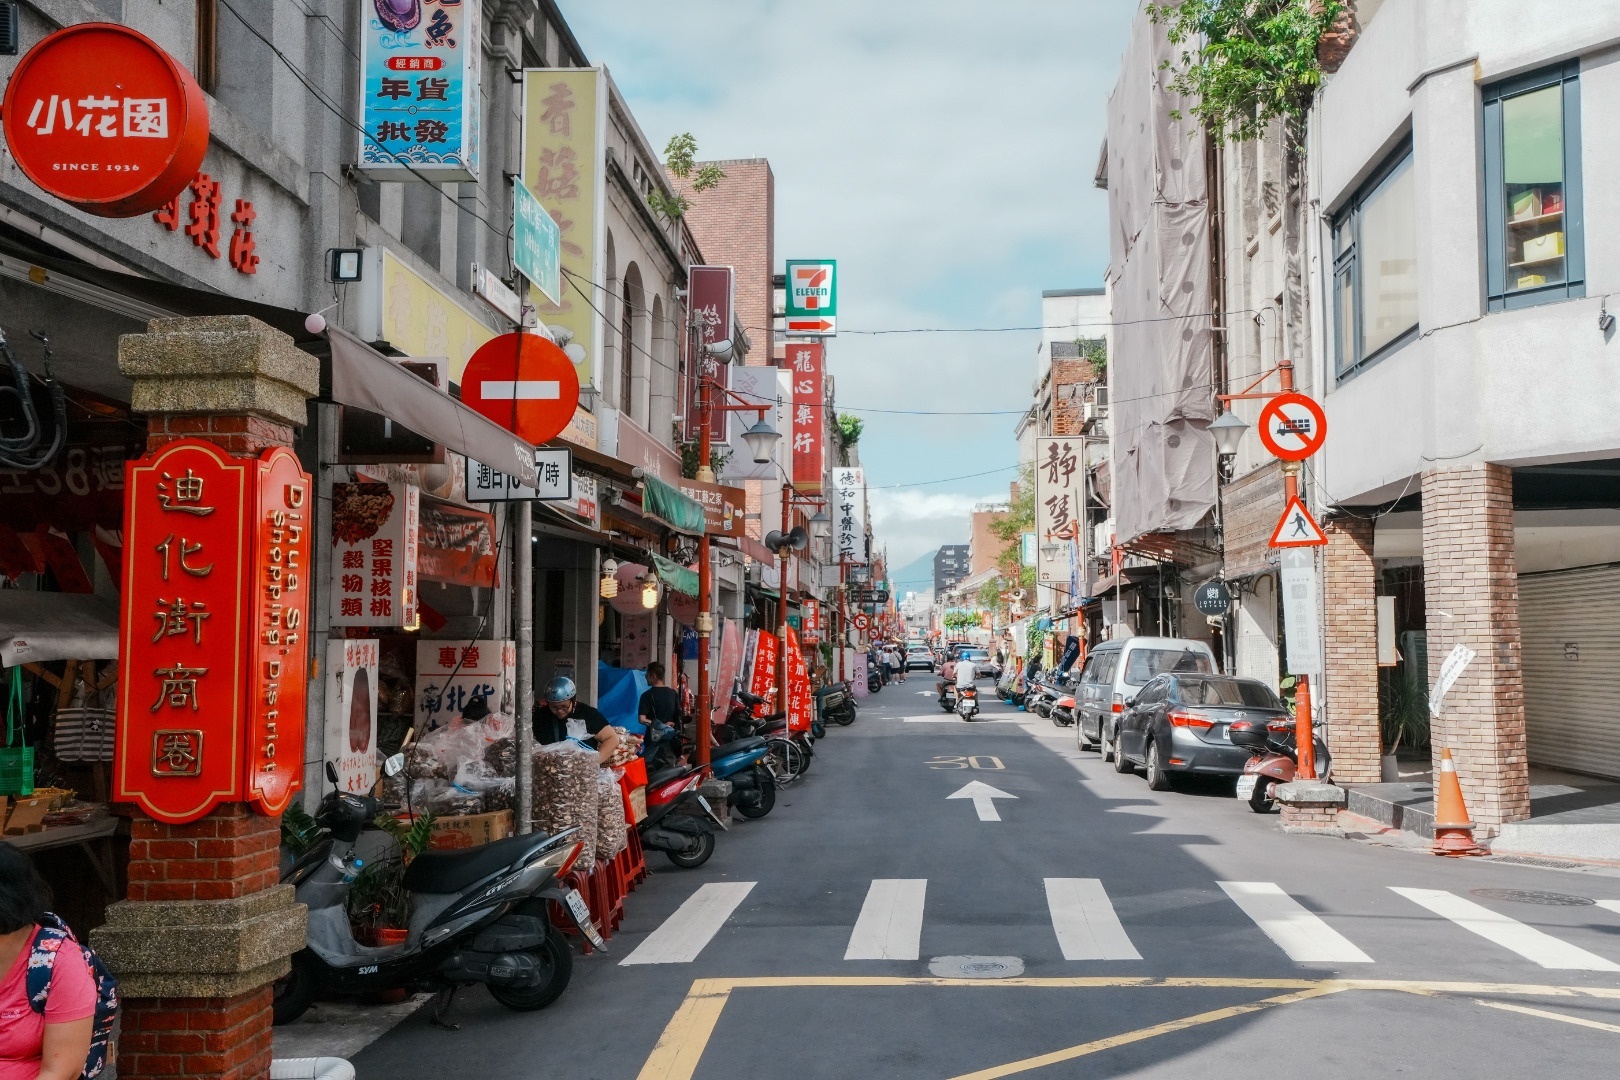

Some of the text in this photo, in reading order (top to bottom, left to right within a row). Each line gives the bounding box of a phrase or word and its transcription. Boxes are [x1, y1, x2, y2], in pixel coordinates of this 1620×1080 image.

[424, 0, 462, 49] 魚
[395, 58, 434, 69] 經銷商
[377, 77, 450, 101] 年貨
[26, 95, 168, 138] 小花園
[376, 119, 449, 143] 批發
[53, 163, 100, 171] SINCE
[793, 350, 815, 454] 龍心藥行
[283, 484, 304, 656] Dihua St.
[341, 550, 364, 617] 穀物類
[370, 538, 393, 617] 堅果核桃
[151, 468, 215, 778] 迪化街商圈
[266, 509, 285, 774] Shopping District
[438, 646, 479, 669] 專營
[921, 755, 1006, 770] 30
[358, 965, 378, 975] SYM
